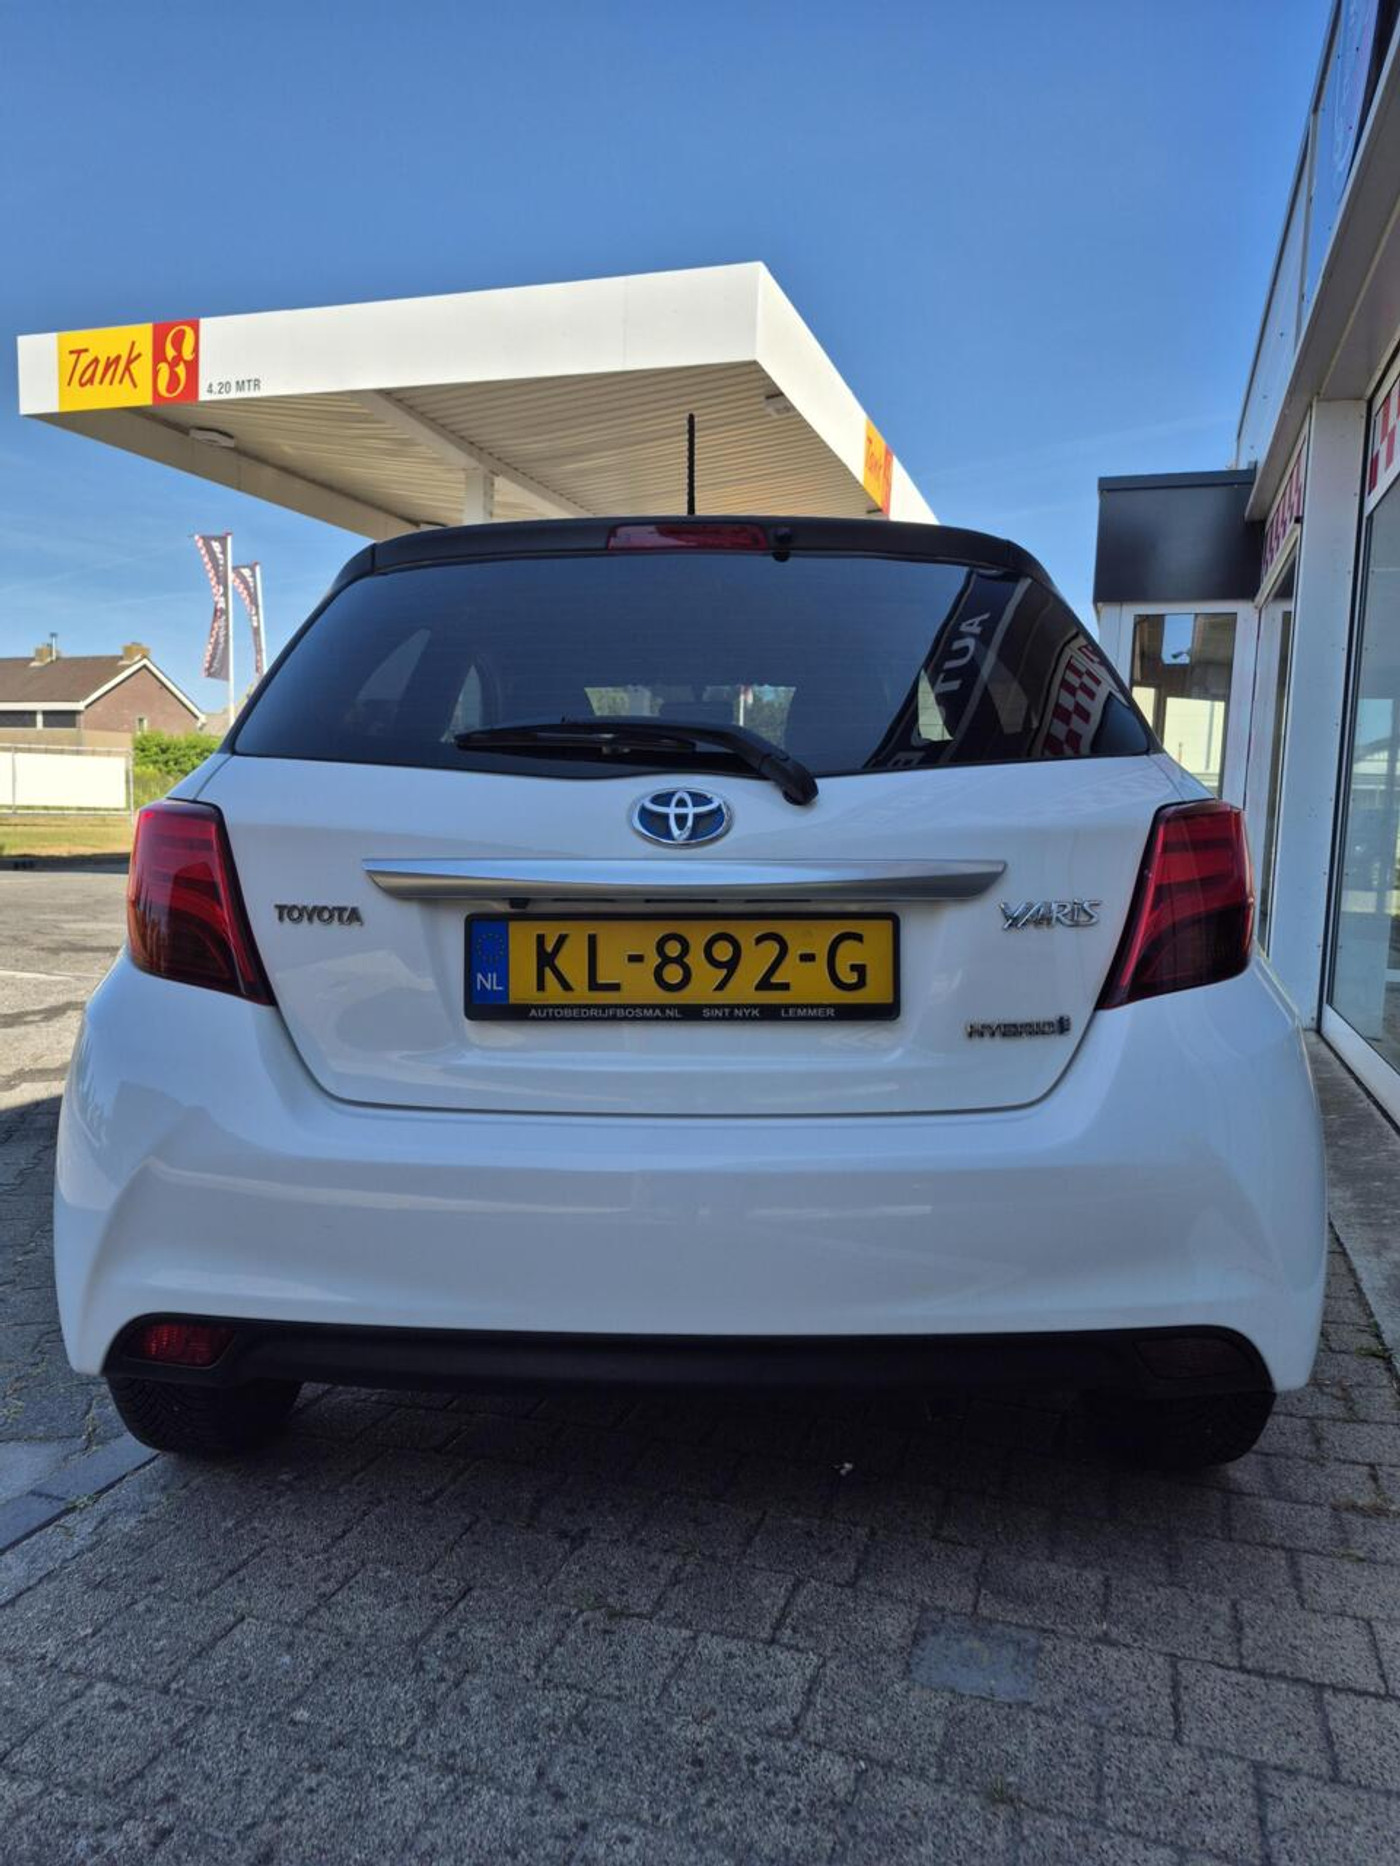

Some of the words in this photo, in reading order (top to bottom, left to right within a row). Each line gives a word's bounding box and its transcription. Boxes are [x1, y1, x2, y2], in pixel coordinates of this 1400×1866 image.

[67, 340, 142, 389] Tank
[206, 380, 232, 396] 4.20
[235, 378, 262, 394] MTR
[273, 904, 365, 926] TOYOTA
[533, 931, 868, 993] KL-892-G
[476, 972, 503, 991] NL
[528, 1008, 682, 1019] AUTOBEDRIJFBOSMA.NL
[702, 1008, 730, 1019] SINT
[734, 1008, 760, 1019] NYK
[781, 1008, 835, 1019] LEMMER
